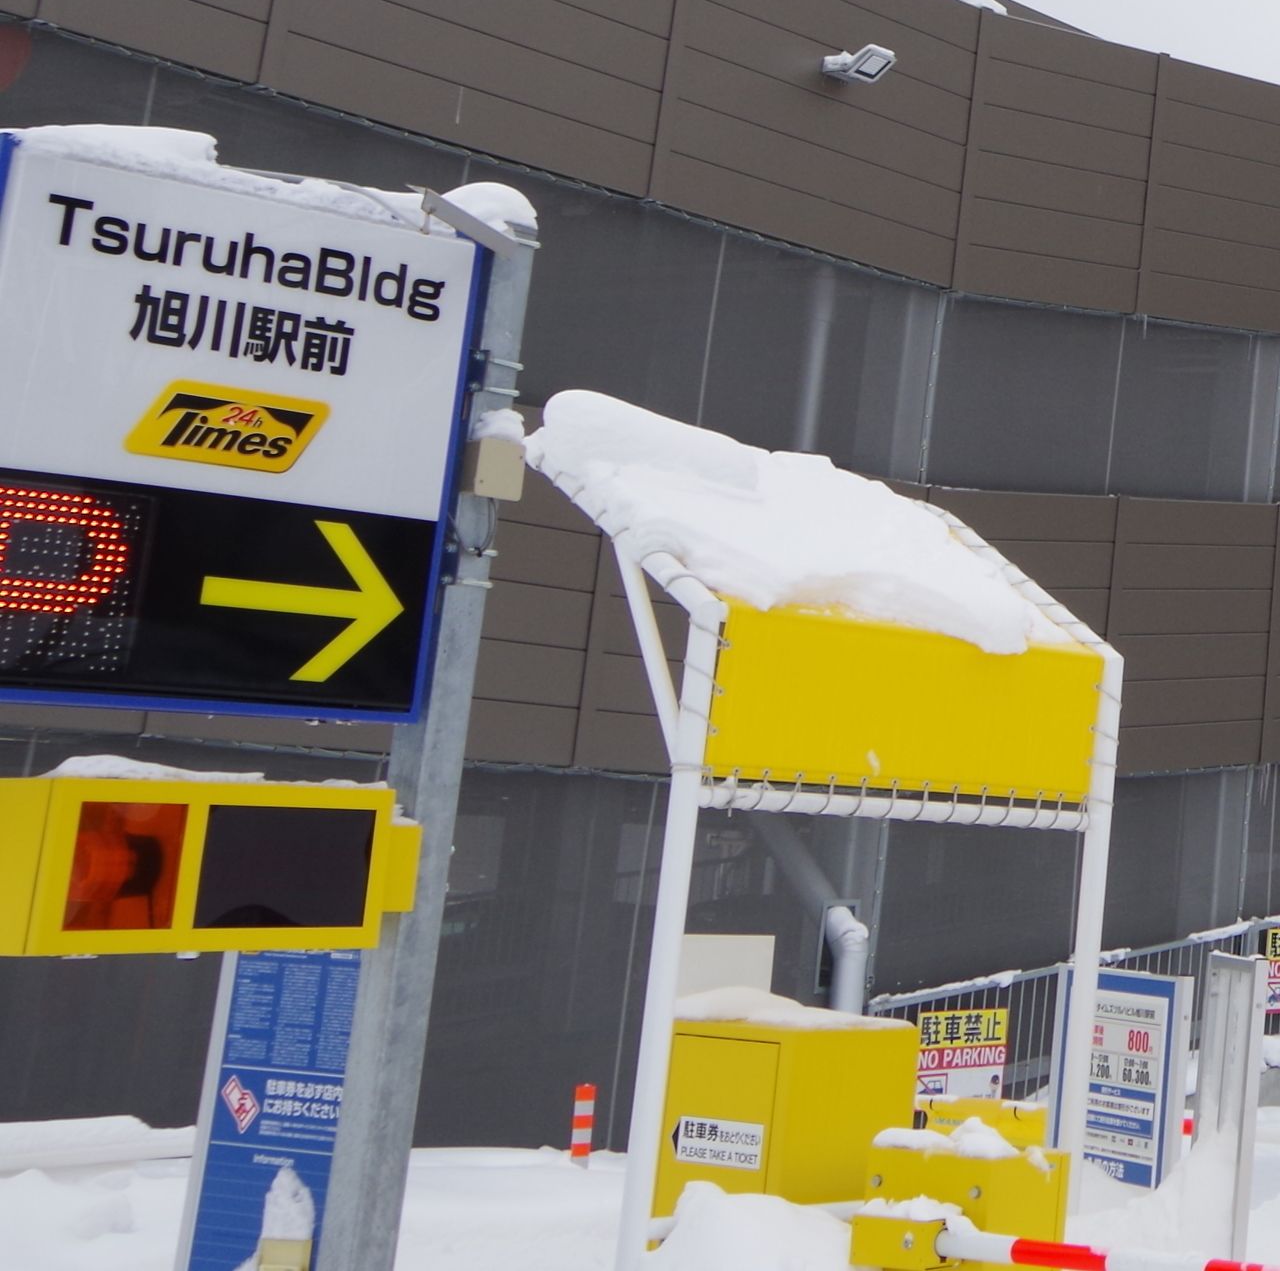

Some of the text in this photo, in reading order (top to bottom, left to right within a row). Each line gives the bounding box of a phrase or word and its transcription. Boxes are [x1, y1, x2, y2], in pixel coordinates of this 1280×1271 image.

[49, 193, 445, 322] TsuruhaBldg
[130, 285, 354, 376] 旭川駅前
[161, 411, 293, 459] Times
[921, 1012, 1001, 1046] 駐車禁止
[918, 1046, 1006, 1069] NO PARKING
[681, 1146, 758, 1165] PLEASE TAKE A TICKET
